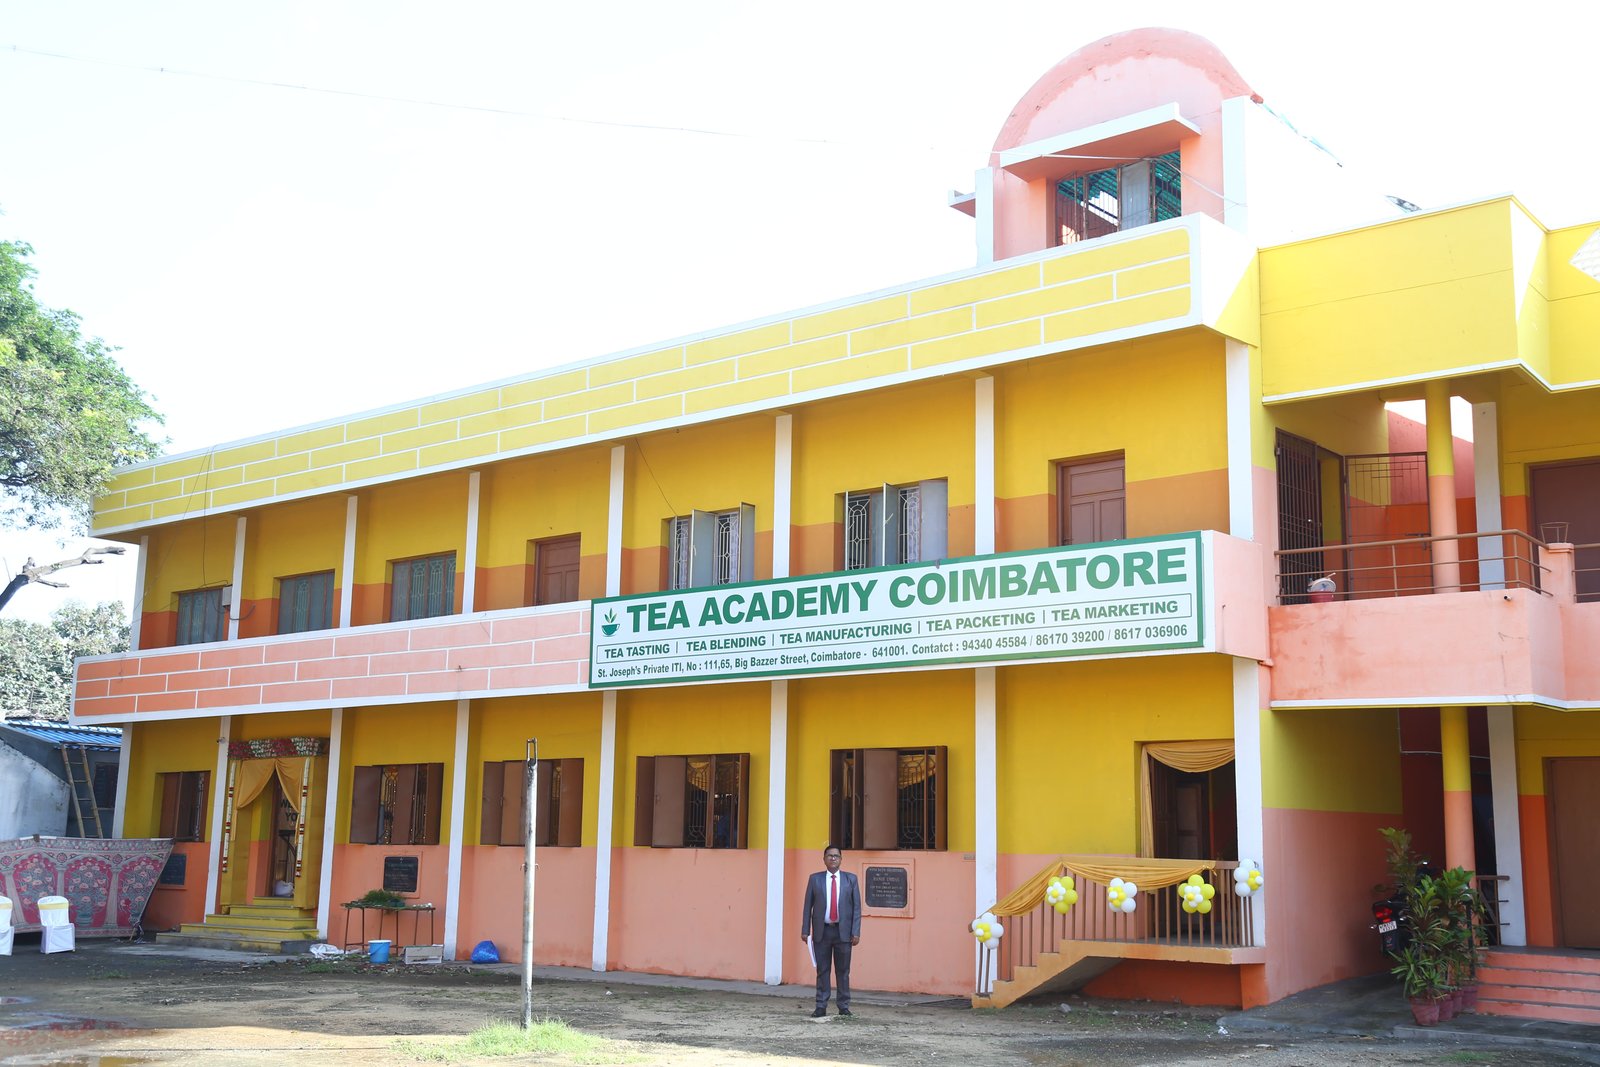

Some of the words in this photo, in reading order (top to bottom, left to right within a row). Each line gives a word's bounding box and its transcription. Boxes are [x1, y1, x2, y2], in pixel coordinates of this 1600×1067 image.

[627, 600, 690, 634] TEA
[698, 580, 878, 627] ACADEMY
[889, 547, 1187, 608] COIMBATORE
[597, 668, 608, 678] St.
[644, 663, 670, 674] Private
[687, 661, 698, 671] No
[735, 658, 748, 671] Big
[750, 657, 778, 668] Bazzer
[780, 654, 809, 666] Street,
[810, 650, 862, 663] Coimbatore
[912, 642, 954, 654] Contatct
[962, 638, 993, 650] 94340
[996, 636, 1027, 649] 45584
[1036, 632, 1069, 645] 86170
[1072, 630, 1105, 643] 39200
[1115, 627, 1142, 640] 8617
[1145, 624, 1188, 638] 036906
[604, 647, 625, 659] TEA
[626, 643, 670, 657] TASTING
[686, 640, 708, 653] TEA
[709, 635, 767, 651] BLENDING
[780, 632, 803, 645] TEA
[806, 622, 913, 642] MANUFACTURING
[926, 619, 952, 632] TEA
[956, 612, 1036, 629] PACKETING
[1052, 609, 1081, 622] TEA
[1085, 600, 1179, 619] MARKETING
